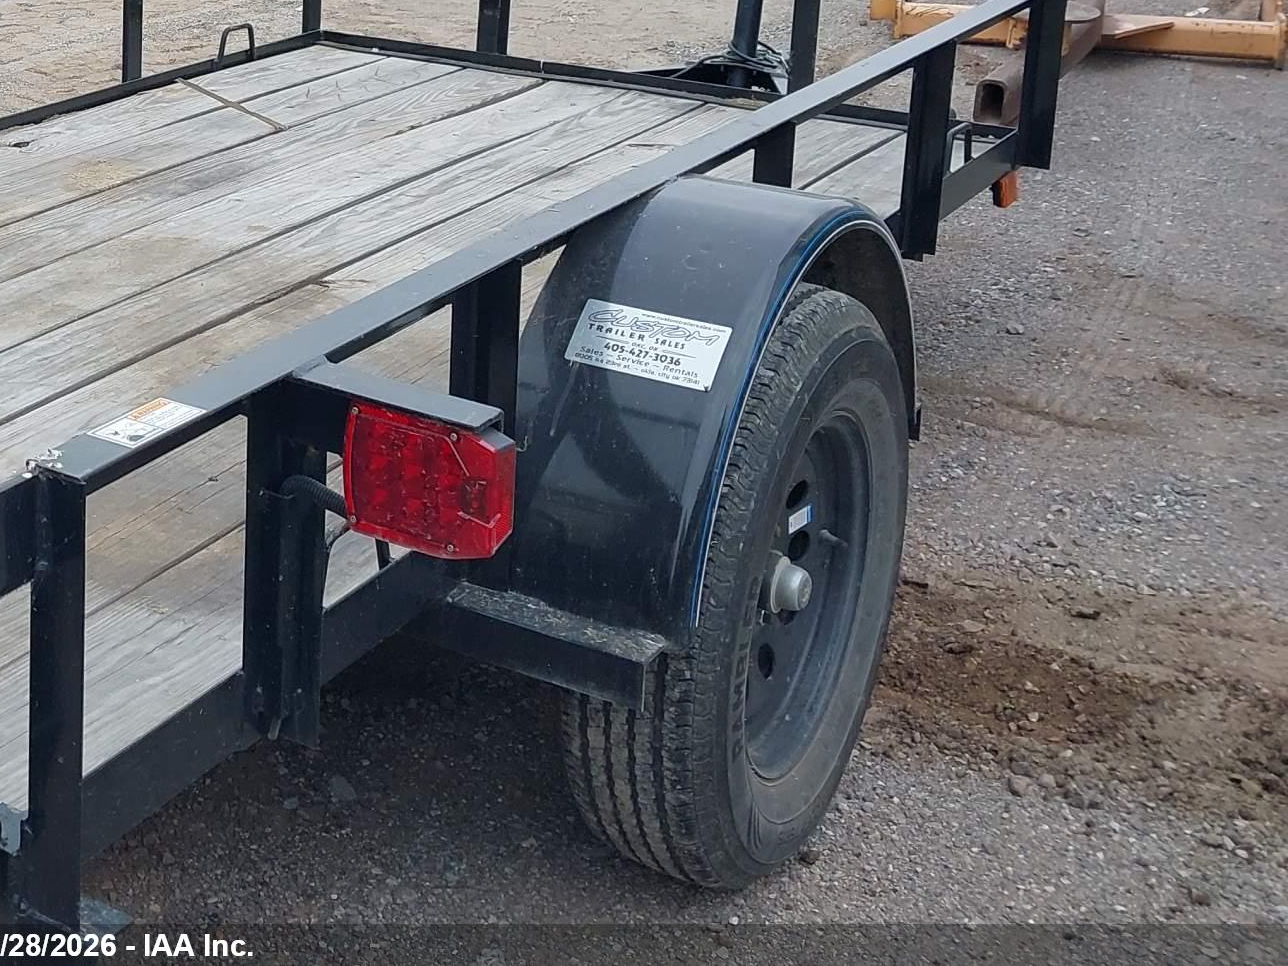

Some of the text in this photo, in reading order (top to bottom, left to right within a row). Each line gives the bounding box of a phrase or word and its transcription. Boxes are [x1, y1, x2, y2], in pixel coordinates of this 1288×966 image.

[588, 309, 720, 346] CUSTOM
[588, 323, 685, 350] TRAILER SALES
[581, 346, 603, 356] Sales
[616, 354, 650, 367] Service
[663, 365, 698, 378] Rentals
[604, 343, 681, 366] 405-427-3036
